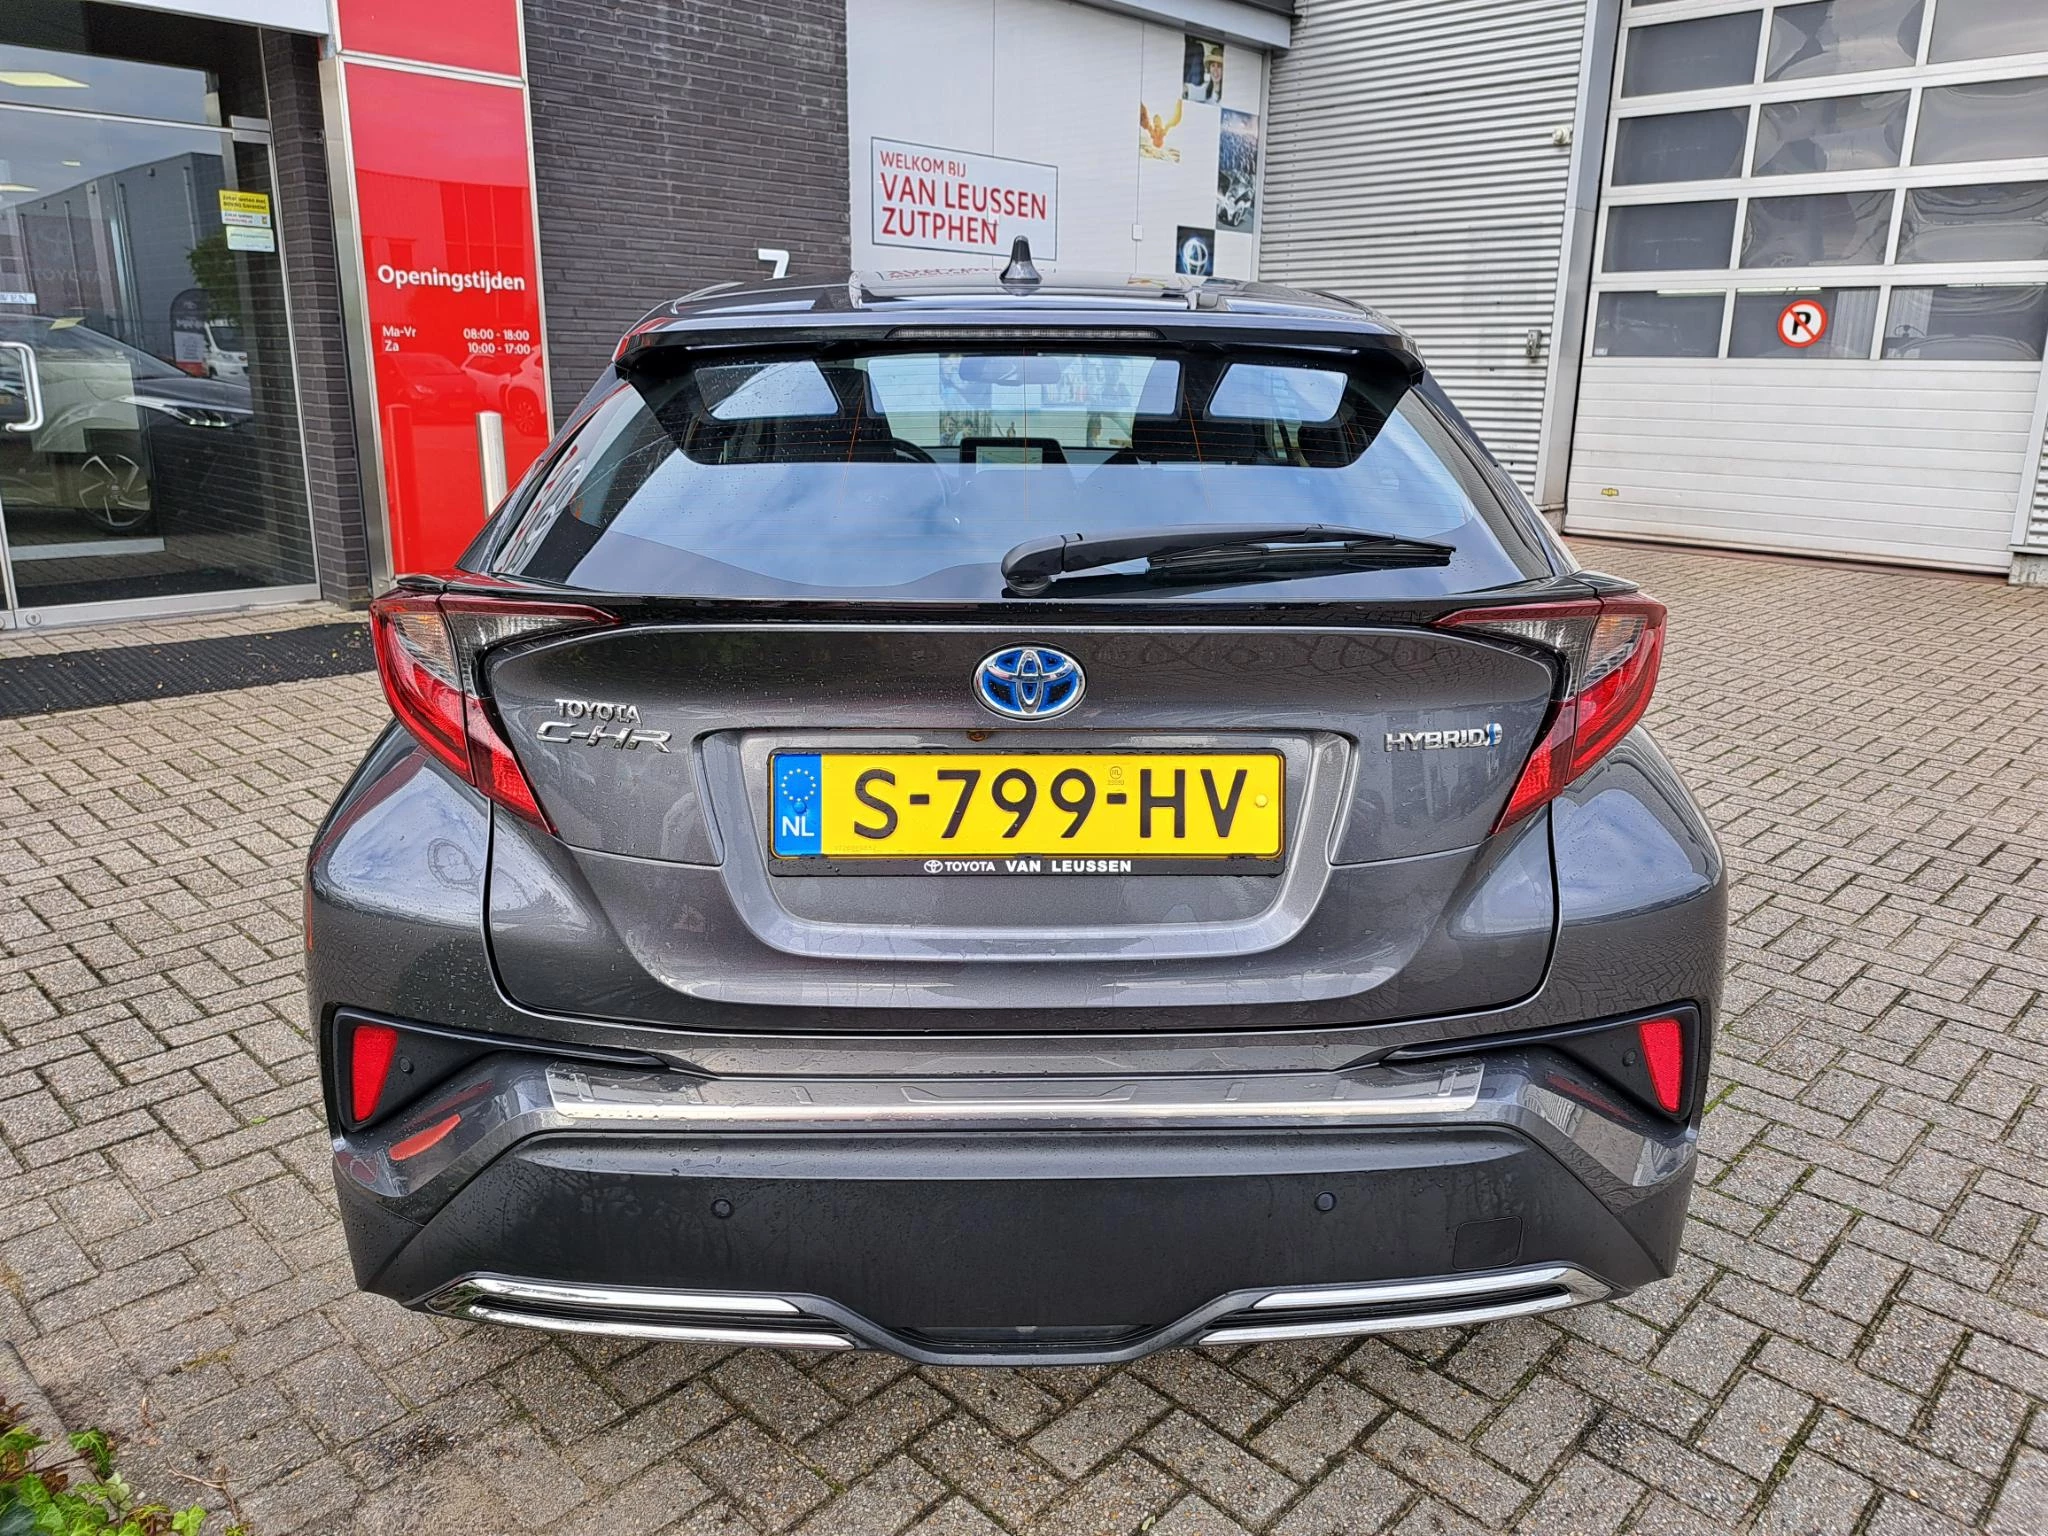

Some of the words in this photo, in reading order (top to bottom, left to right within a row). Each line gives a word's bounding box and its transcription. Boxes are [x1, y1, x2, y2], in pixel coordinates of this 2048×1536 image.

[880, 150, 945, 175] WELKOM
[948, 161, 966, 178] BIJ
[880, 172, 936, 207] VAN
[944, 181, 1047, 220] LEUSSEN
[882, 207, 998, 246] ZUTPHEN
[758, 248, 790, 279] 7
[377, 264, 526, 293] Openingstijden
[382, 325, 417, 338] Ma-Vr
[463, 328, 494, 340] 08:00
[503, 329, 530, 341] 18:00
[1791, 311, 1812, 336] P
[384, 340, 400, 352] Za
[468, 342, 496, 354] 10:00
[504, 343, 531, 355] 17:00
[555, 698, 643, 725] TOYOTA
[536, 721, 672, 753] C-HR
[1384, 729, 1486, 752] HYBRID
[853, 768, 1248, 840] S-799-HV
[782, 816, 815, 837] NL
[945, 861, 996, 872] TOYOTA
[1005, 860, 1041, 873] VAN
[1052, 860, 1132, 873] LEUSSEN
